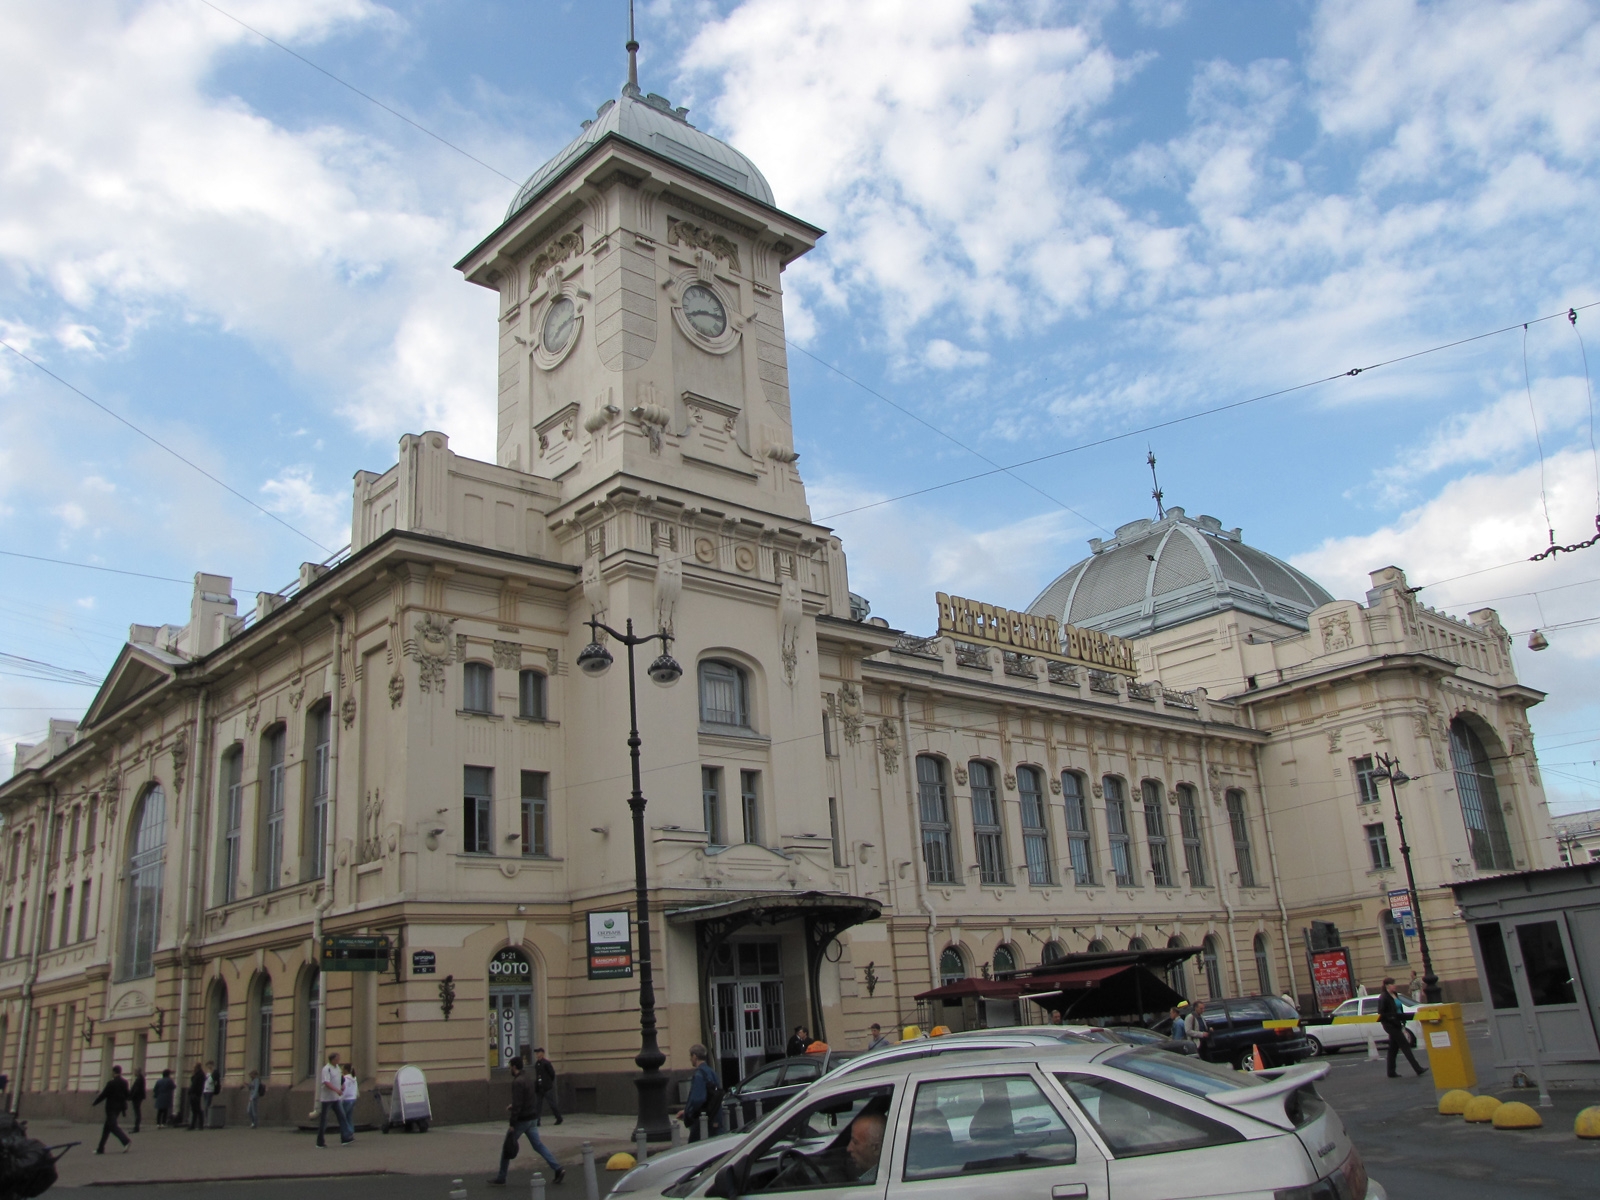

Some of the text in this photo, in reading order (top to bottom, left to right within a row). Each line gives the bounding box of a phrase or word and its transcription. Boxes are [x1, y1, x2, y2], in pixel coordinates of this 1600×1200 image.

[935, 591, 1137, 671] ВИТЕБСКИЙ ВОКЗАЛ
[489, 960, 529, 974] ФОТО
[502, 1008, 514, 1058] ФОТО
